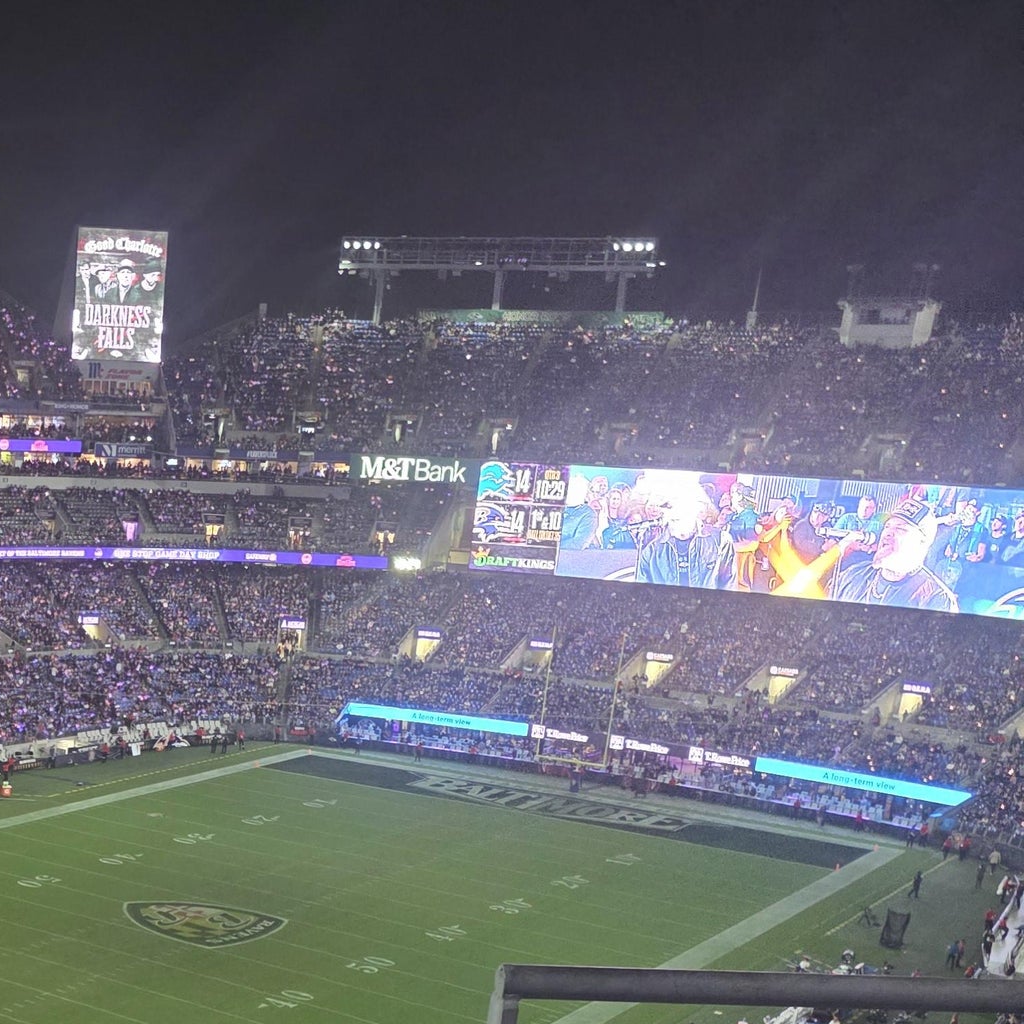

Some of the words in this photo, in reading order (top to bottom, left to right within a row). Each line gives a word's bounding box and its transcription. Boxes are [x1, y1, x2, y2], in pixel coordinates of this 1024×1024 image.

[85, 303, 151, 328] DARKNESS
[97, 327, 135, 350] FALLS
[118, 446, 145, 454] merritt
[360, 456, 414, 481] M&T
[414, 458, 466, 483] Bank
[516, 468, 531, 493] 14
[536, 480, 566, 500] 10:29
[510, 510, 525, 533] 14
[549, 511, 562, 531] 10
[113, 549, 131, 559] ONE
[132, 550, 154, 559] STOP
[155, 550, 179, 559] GAME
[179, 550, 196, 560] DAY
[197, 551, 220, 560] SHOP
[474, 555, 555, 570] DRAFTKINGS
[418, 713, 453, 725] long-term
[455, 717, 471, 726] view
[822, 772, 829, 780] A
[830, 773, 874, 788] long-term
[875, 781, 896, 791] view
[416, 776, 688, 832] BALTIMORE
[346, 955, 396, 974] 50
[266, 988, 314, 1010] 40
